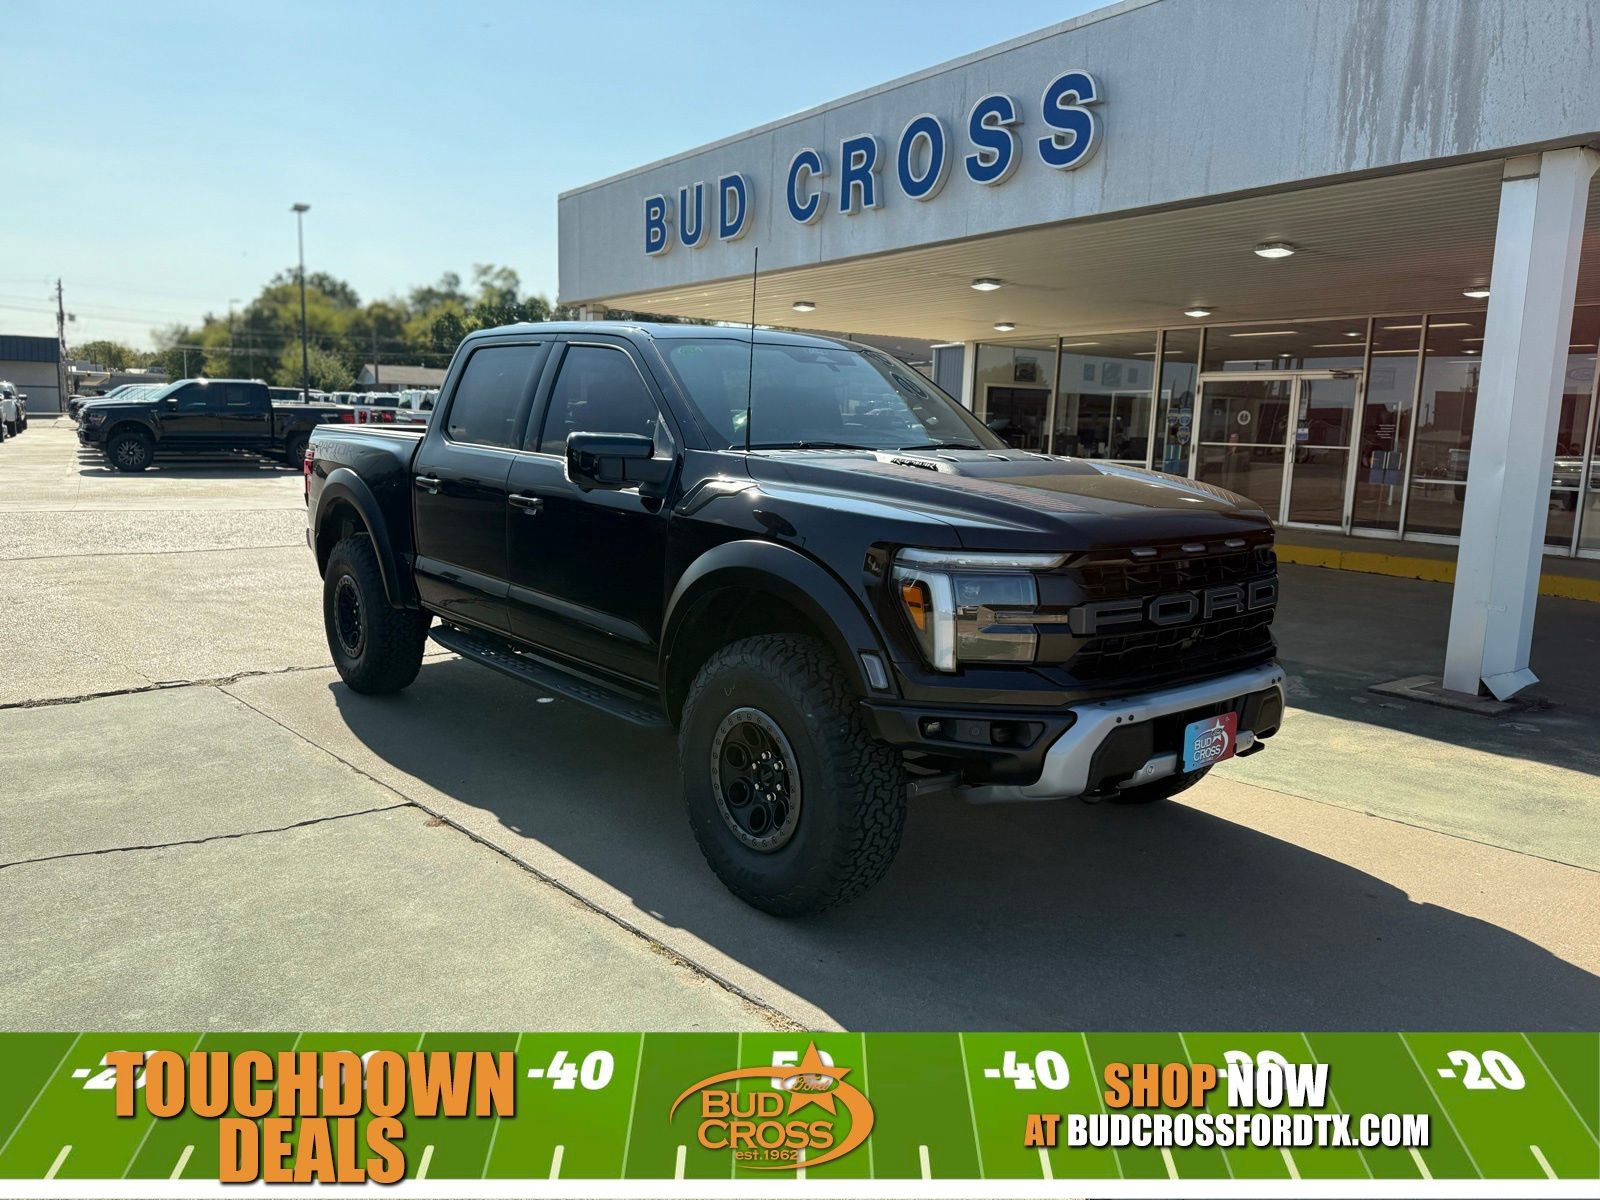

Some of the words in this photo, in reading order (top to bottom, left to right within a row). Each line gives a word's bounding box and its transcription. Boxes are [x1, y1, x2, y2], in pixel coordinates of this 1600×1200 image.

[644, 171, 753, 256] BUD
[786, 69, 1102, 226] CROSS
[1069, 575, 1279, 635] FORD
[1193, 745, 1221, 761] CROSS
[1194, 738, 1212, 750] BUD
